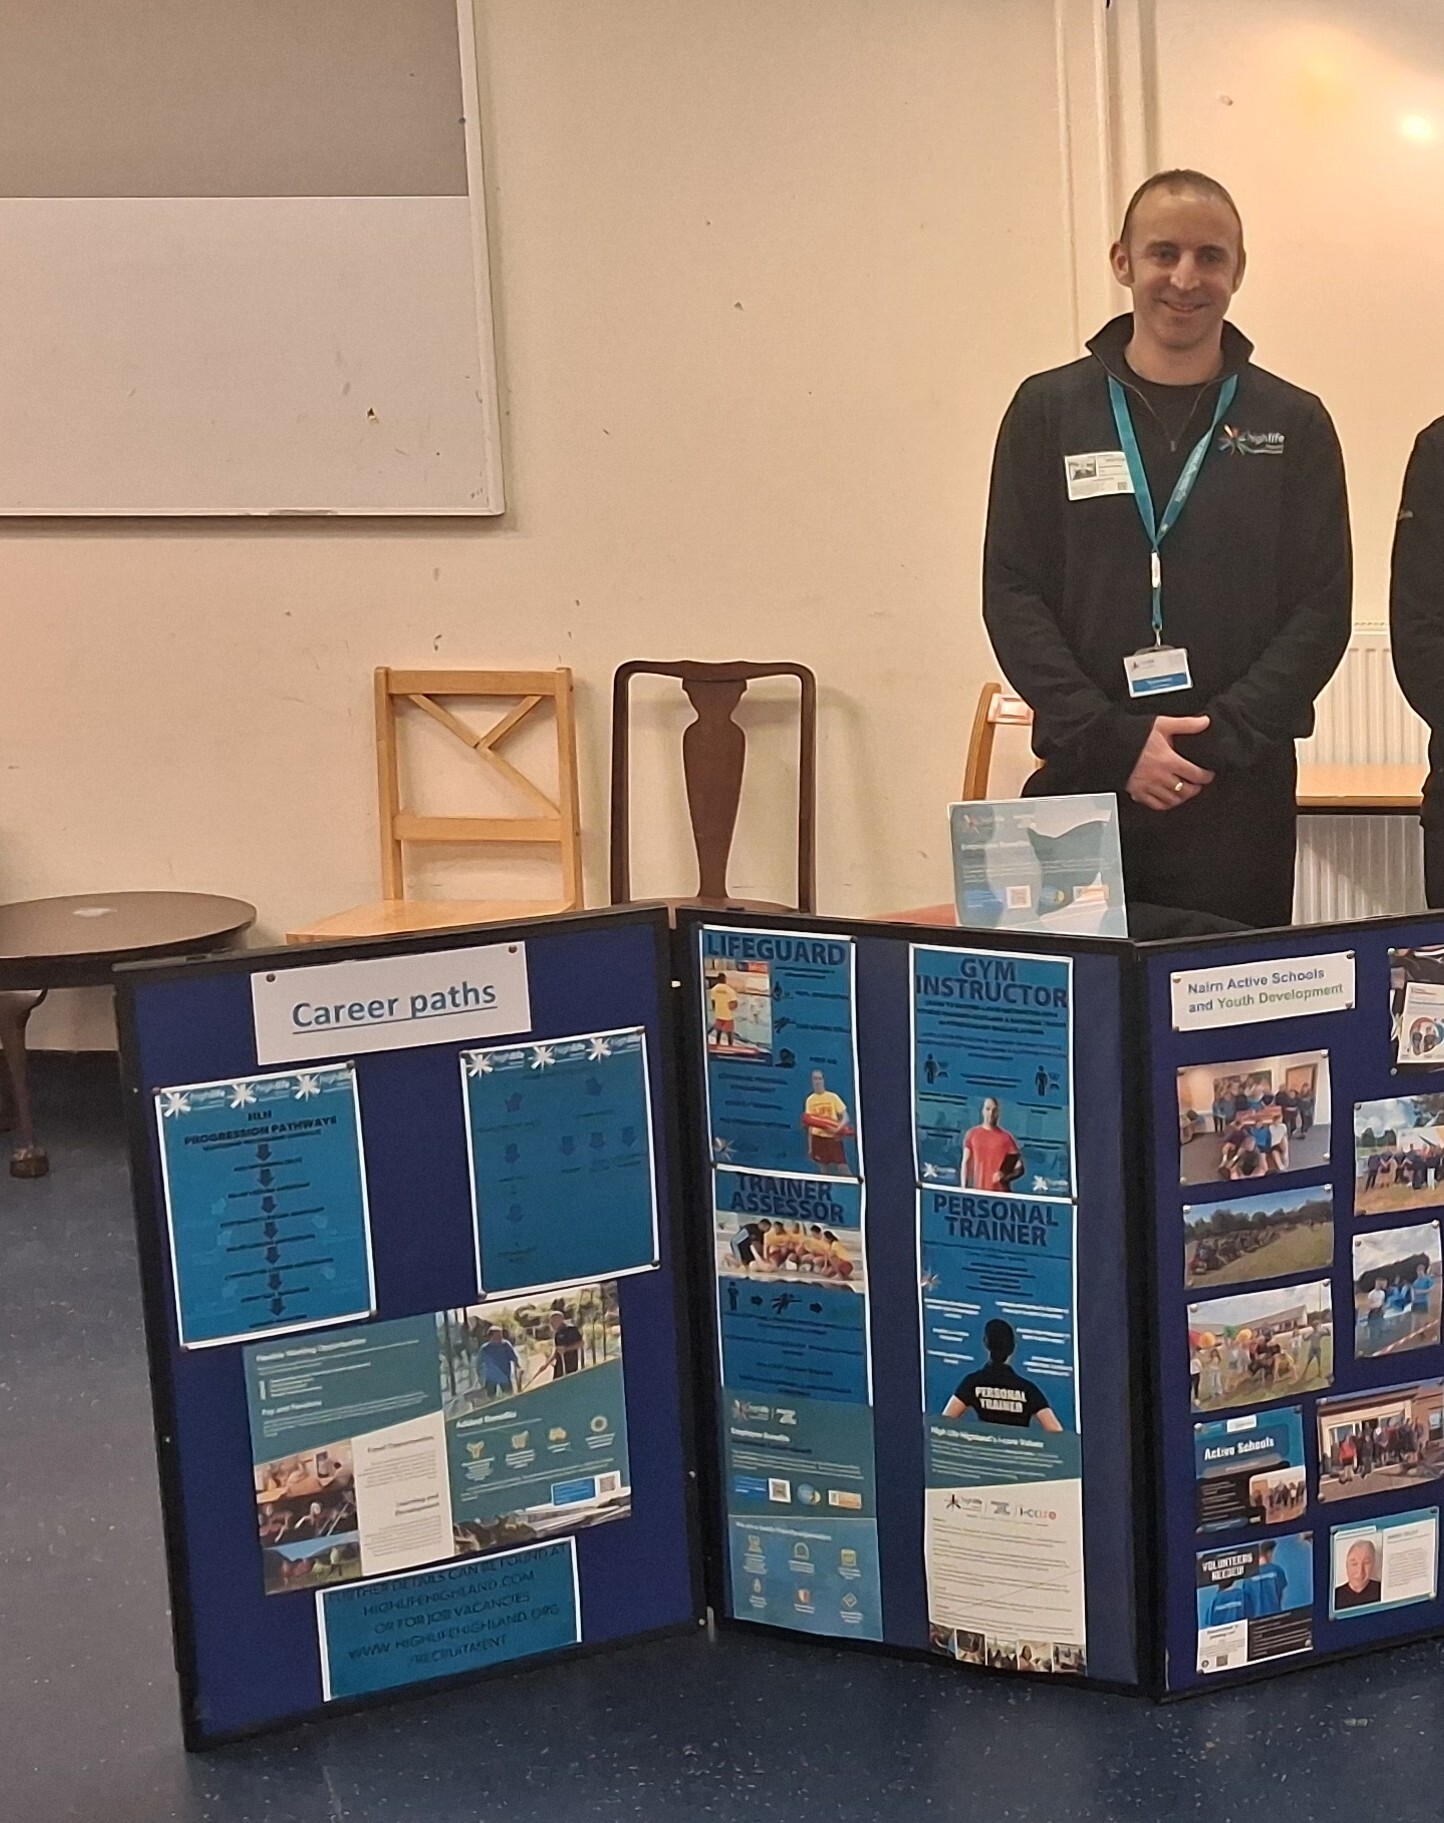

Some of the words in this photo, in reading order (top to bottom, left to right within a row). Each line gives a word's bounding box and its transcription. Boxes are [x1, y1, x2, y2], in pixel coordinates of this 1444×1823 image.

[707, 934, 846, 965] LIFEGUARD
[960, 958, 1016, 982] GYM
[1188, 981, 1223, 994] Nairn
[1227, 975, 1267, 990] Active
[1272, 969, 1324, 984] Schools
[292, 997, 399, 1028] Career
[409, 981, 497, 1019] paths
[916, 975, 1068, 1008] INSTRUCTOR
[1189, 1000, 1213, 1013] and
[1217, 994, 1255, 1008] Youth
[1259, 984, 1343, 1003] Development
[184, 1127, 269, 1146] PROGRESSION
[271, 1115, 337, 1134] PATHWAYS
[736, 1172, 832, 1201] TRAINER
[731, 1191, 845, 1223] ASSESSOR
[933, 1193, 1059, 1226] PERSONAL
[944, 1216, 1047, 1247] TRAINER
[1204, 1447, 1236, 1460] Active
[1237, 1436, 1274, 1454] Schools
[448, 1564, 479, 1581] CAN
[1202, 1553, 1253, 1572] VOLUNTEERS
[454, 1592, 530, 1618] VACANCIES
